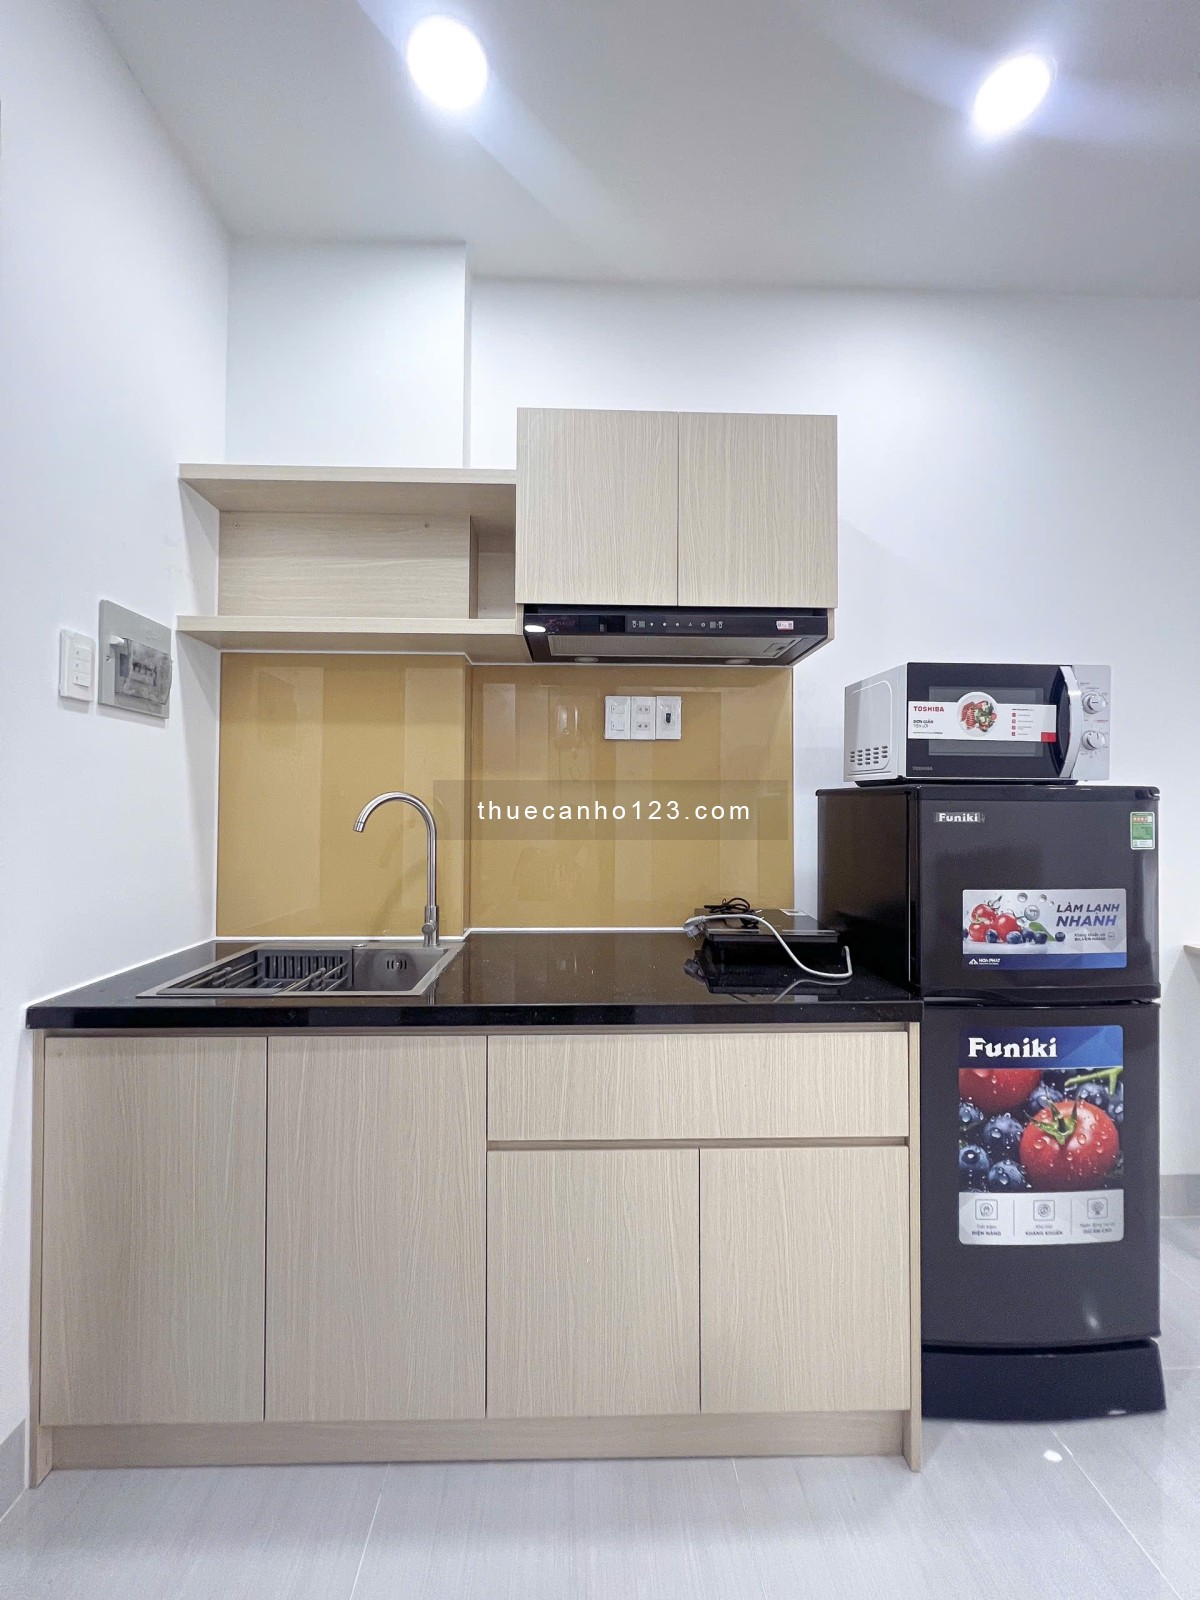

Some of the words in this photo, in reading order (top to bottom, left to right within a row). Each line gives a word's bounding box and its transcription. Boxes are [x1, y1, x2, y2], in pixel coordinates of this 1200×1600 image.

[938, 812, 978, 822] Funiki
[1056, 915, 1117, 927] NHANH
[967, 1037, 1058, 1058] Funiki
